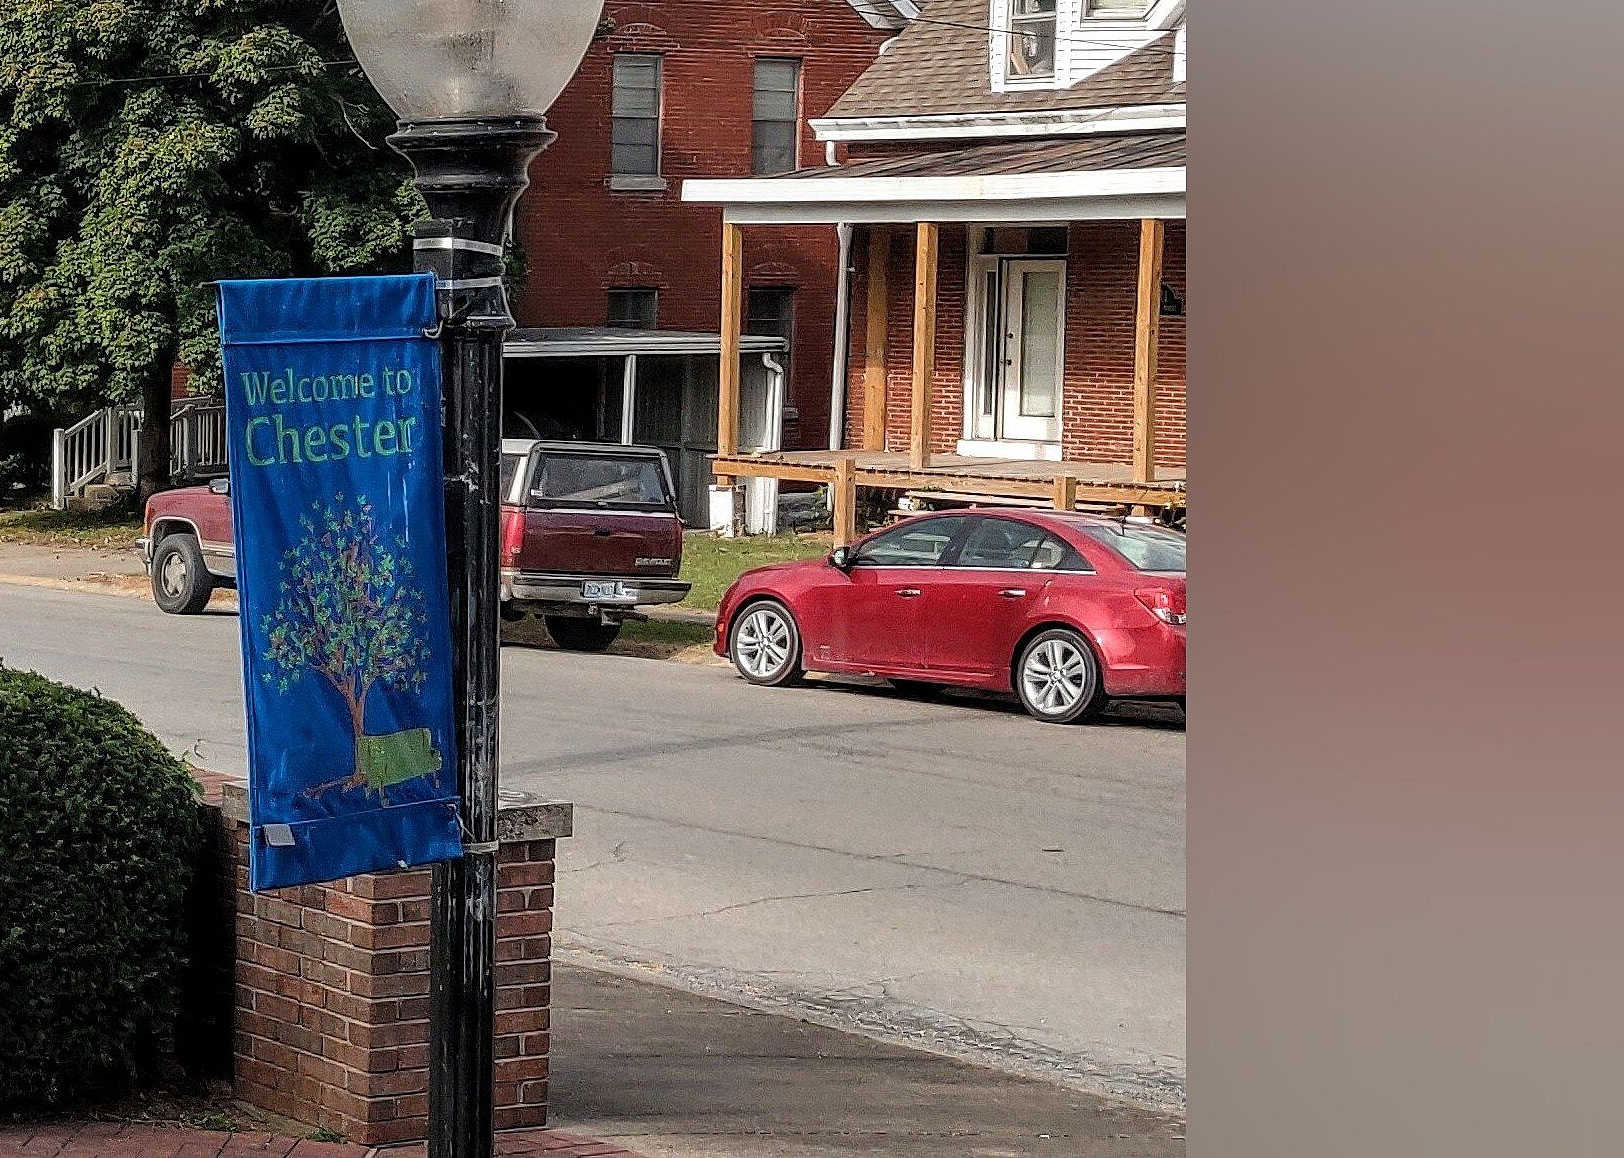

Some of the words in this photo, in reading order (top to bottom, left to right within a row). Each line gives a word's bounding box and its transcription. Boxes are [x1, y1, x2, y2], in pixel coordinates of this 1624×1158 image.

[240, 368, 375, 406] Welcome
[382, 366, 412, 396] to
[245, 414, 417, 466] Chester
